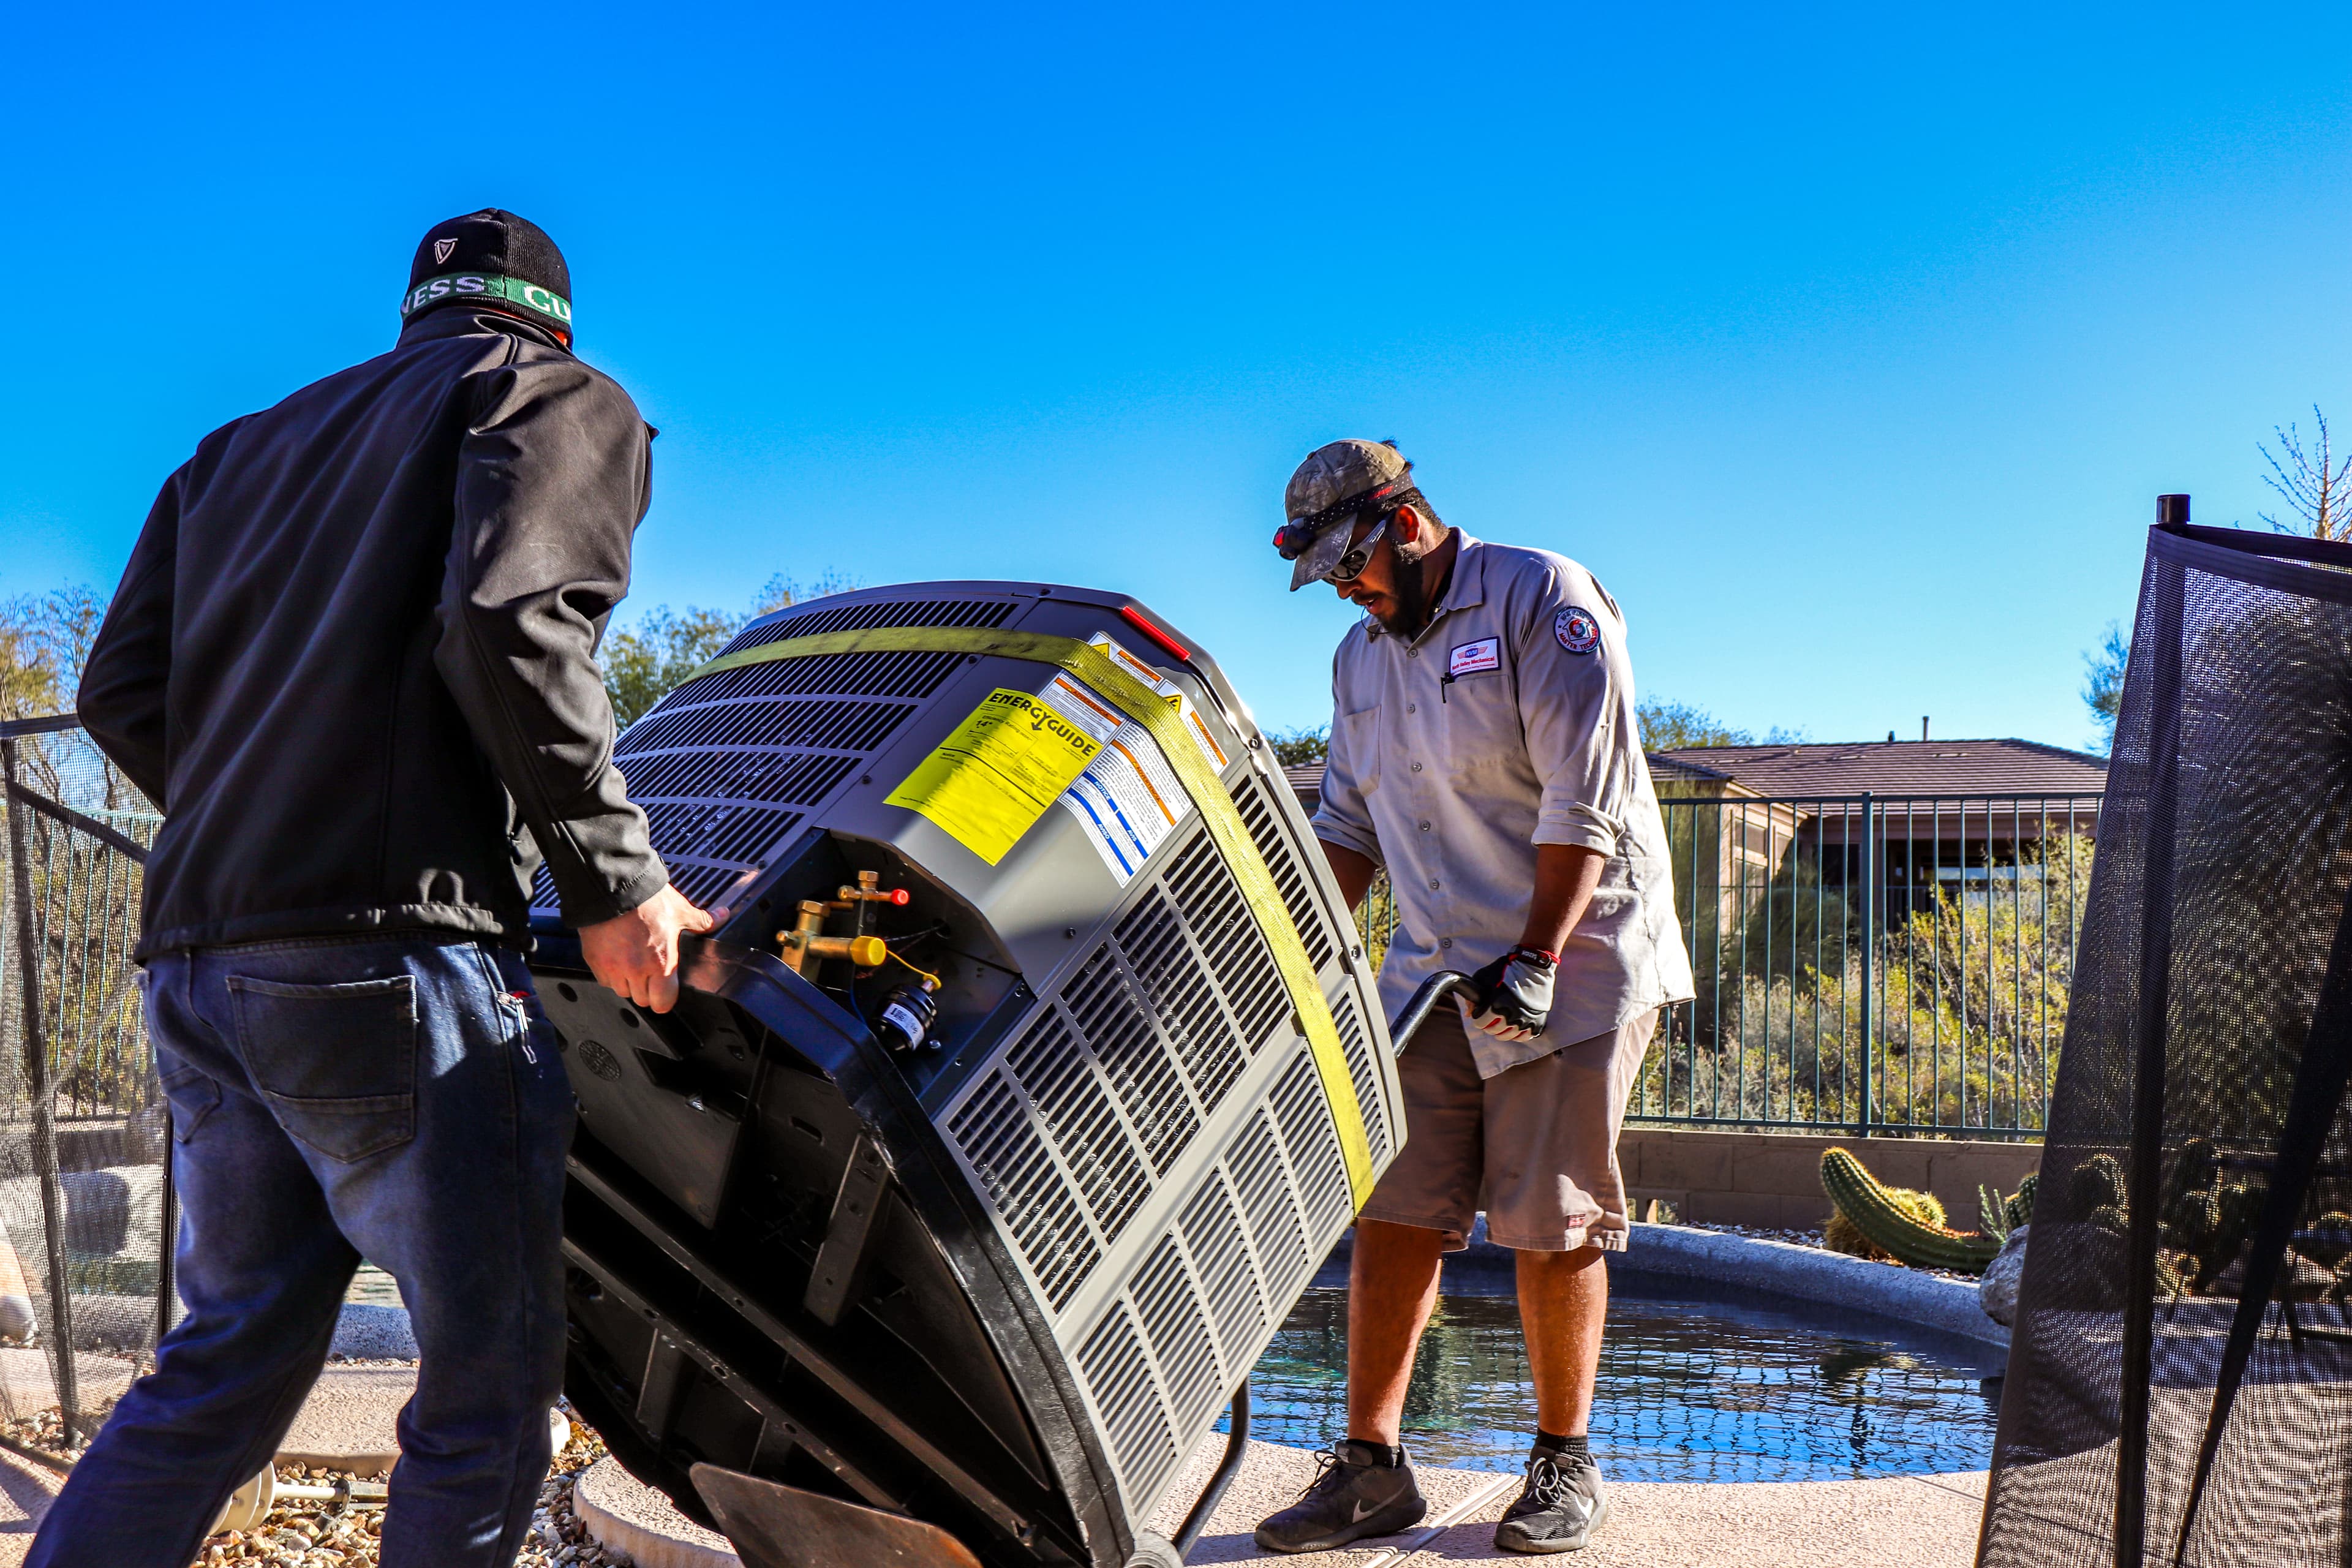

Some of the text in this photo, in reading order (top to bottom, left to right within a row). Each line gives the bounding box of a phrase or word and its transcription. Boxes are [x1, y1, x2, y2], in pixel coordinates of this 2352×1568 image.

[1558, 633, 1578, 650] MASTER
[1129, 658, 1155, 676] WARNING
[1072, 690, 1109, 717] ADVERTENCIA
[988, 692, 1096, 757] ENERGYGUIDE
[1095, 780, 1110, 801] NOTICE
[1137, 765, 1161, 802] ADVERTENCIA
[1097, 823, 1110, 840] AVISO
[1127, 829, 1137, 842] AVIS
